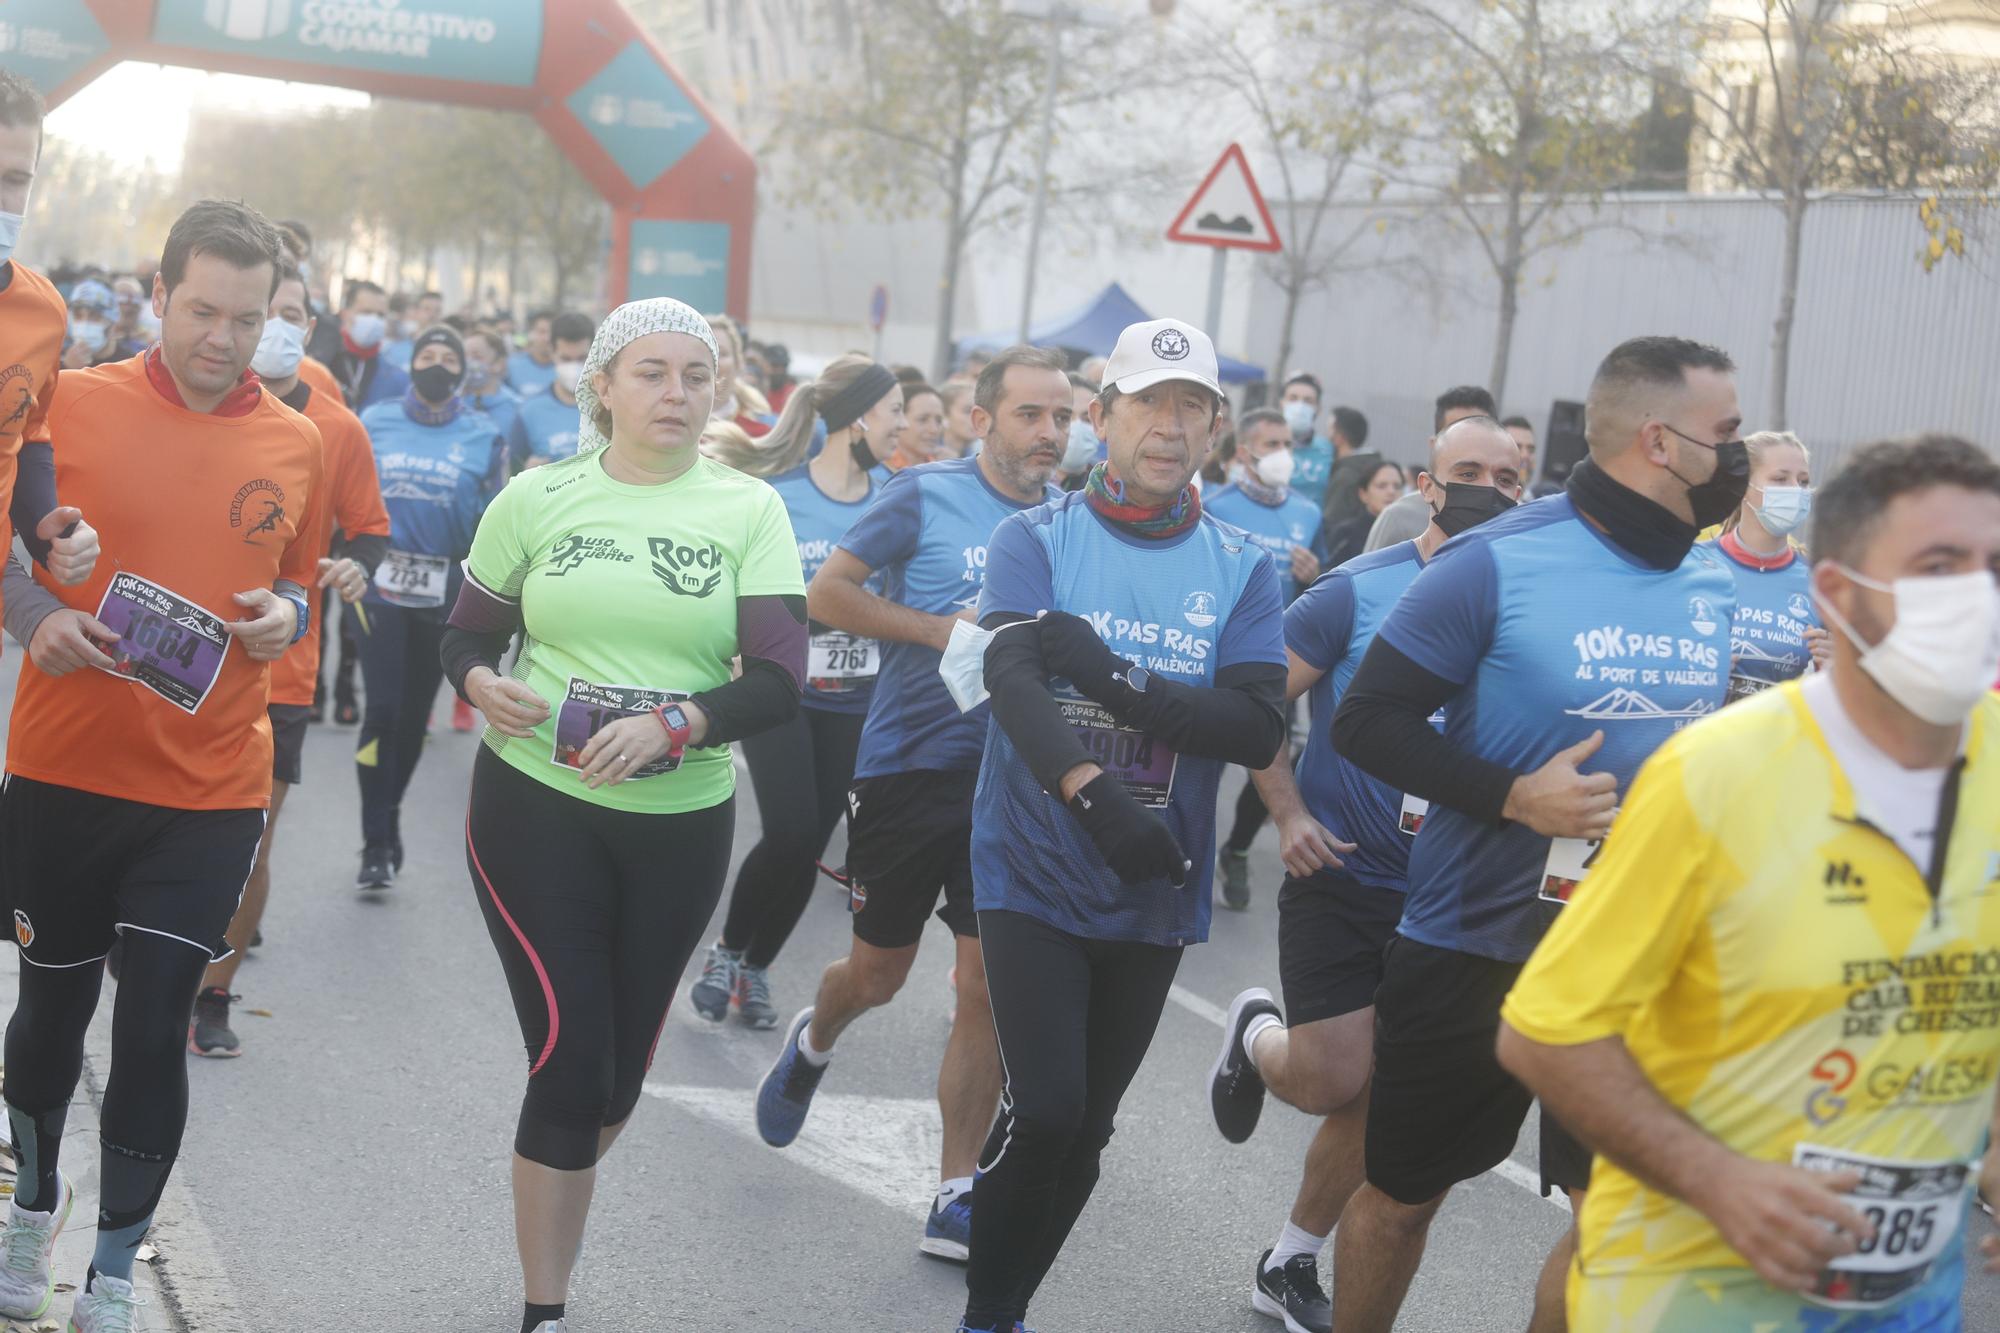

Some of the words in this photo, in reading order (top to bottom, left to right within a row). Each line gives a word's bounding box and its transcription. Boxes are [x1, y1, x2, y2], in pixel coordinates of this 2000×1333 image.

[298, 24, 431, 58] CAJAMAR
[646, 537, 723, 573] Rock
[962, 546, 988, 569] 10
[388, 565, 430, 589] 2734
[681, 573, 700, 587] fm
[962, 569, 976, 581] AL
[117, 577, 139, 592] 10K
[137, 583, 157, 598] PAS
[155, 594, 174, 611] RAS
[121, 590, 137, 601] PORT
[137, 597, 146, 605] DE
[1741, 606, 1774, 624] PAS
[1776, 613, 1806, 637] RAS
[123, 609, 202, 670] 1664
[1114, 618, 1161, 645] PAS
[1163, 628, 1212, 660] RAS
[1749, 628, 1763, 640] DE
[1573, 625, 1627, 664] 10K
[1625, 633, 1673, 659] PAS
[1677, 638, 1720, 670] RAS
[826, 648, 869, 671] 2763
[1146, 654, 1205, 676] VALÈNCIA
[1575, 664, 1594, 680] AL
[1600, 666, 1637, 684] PORT
[1641, 669, 1661, 685] DE
[1664, 664, 1718, 686] VALÈNCIA
[576, 694, 591, 702] PORT
[604, 690, 624, 703] RAS
[1061, 704, 1076, 716] 0K
[1076, 707, 1097, 717] PAS
[1097, 710, 1116, 723] RAS
[1842, 1014, 1885, 1038] DE
